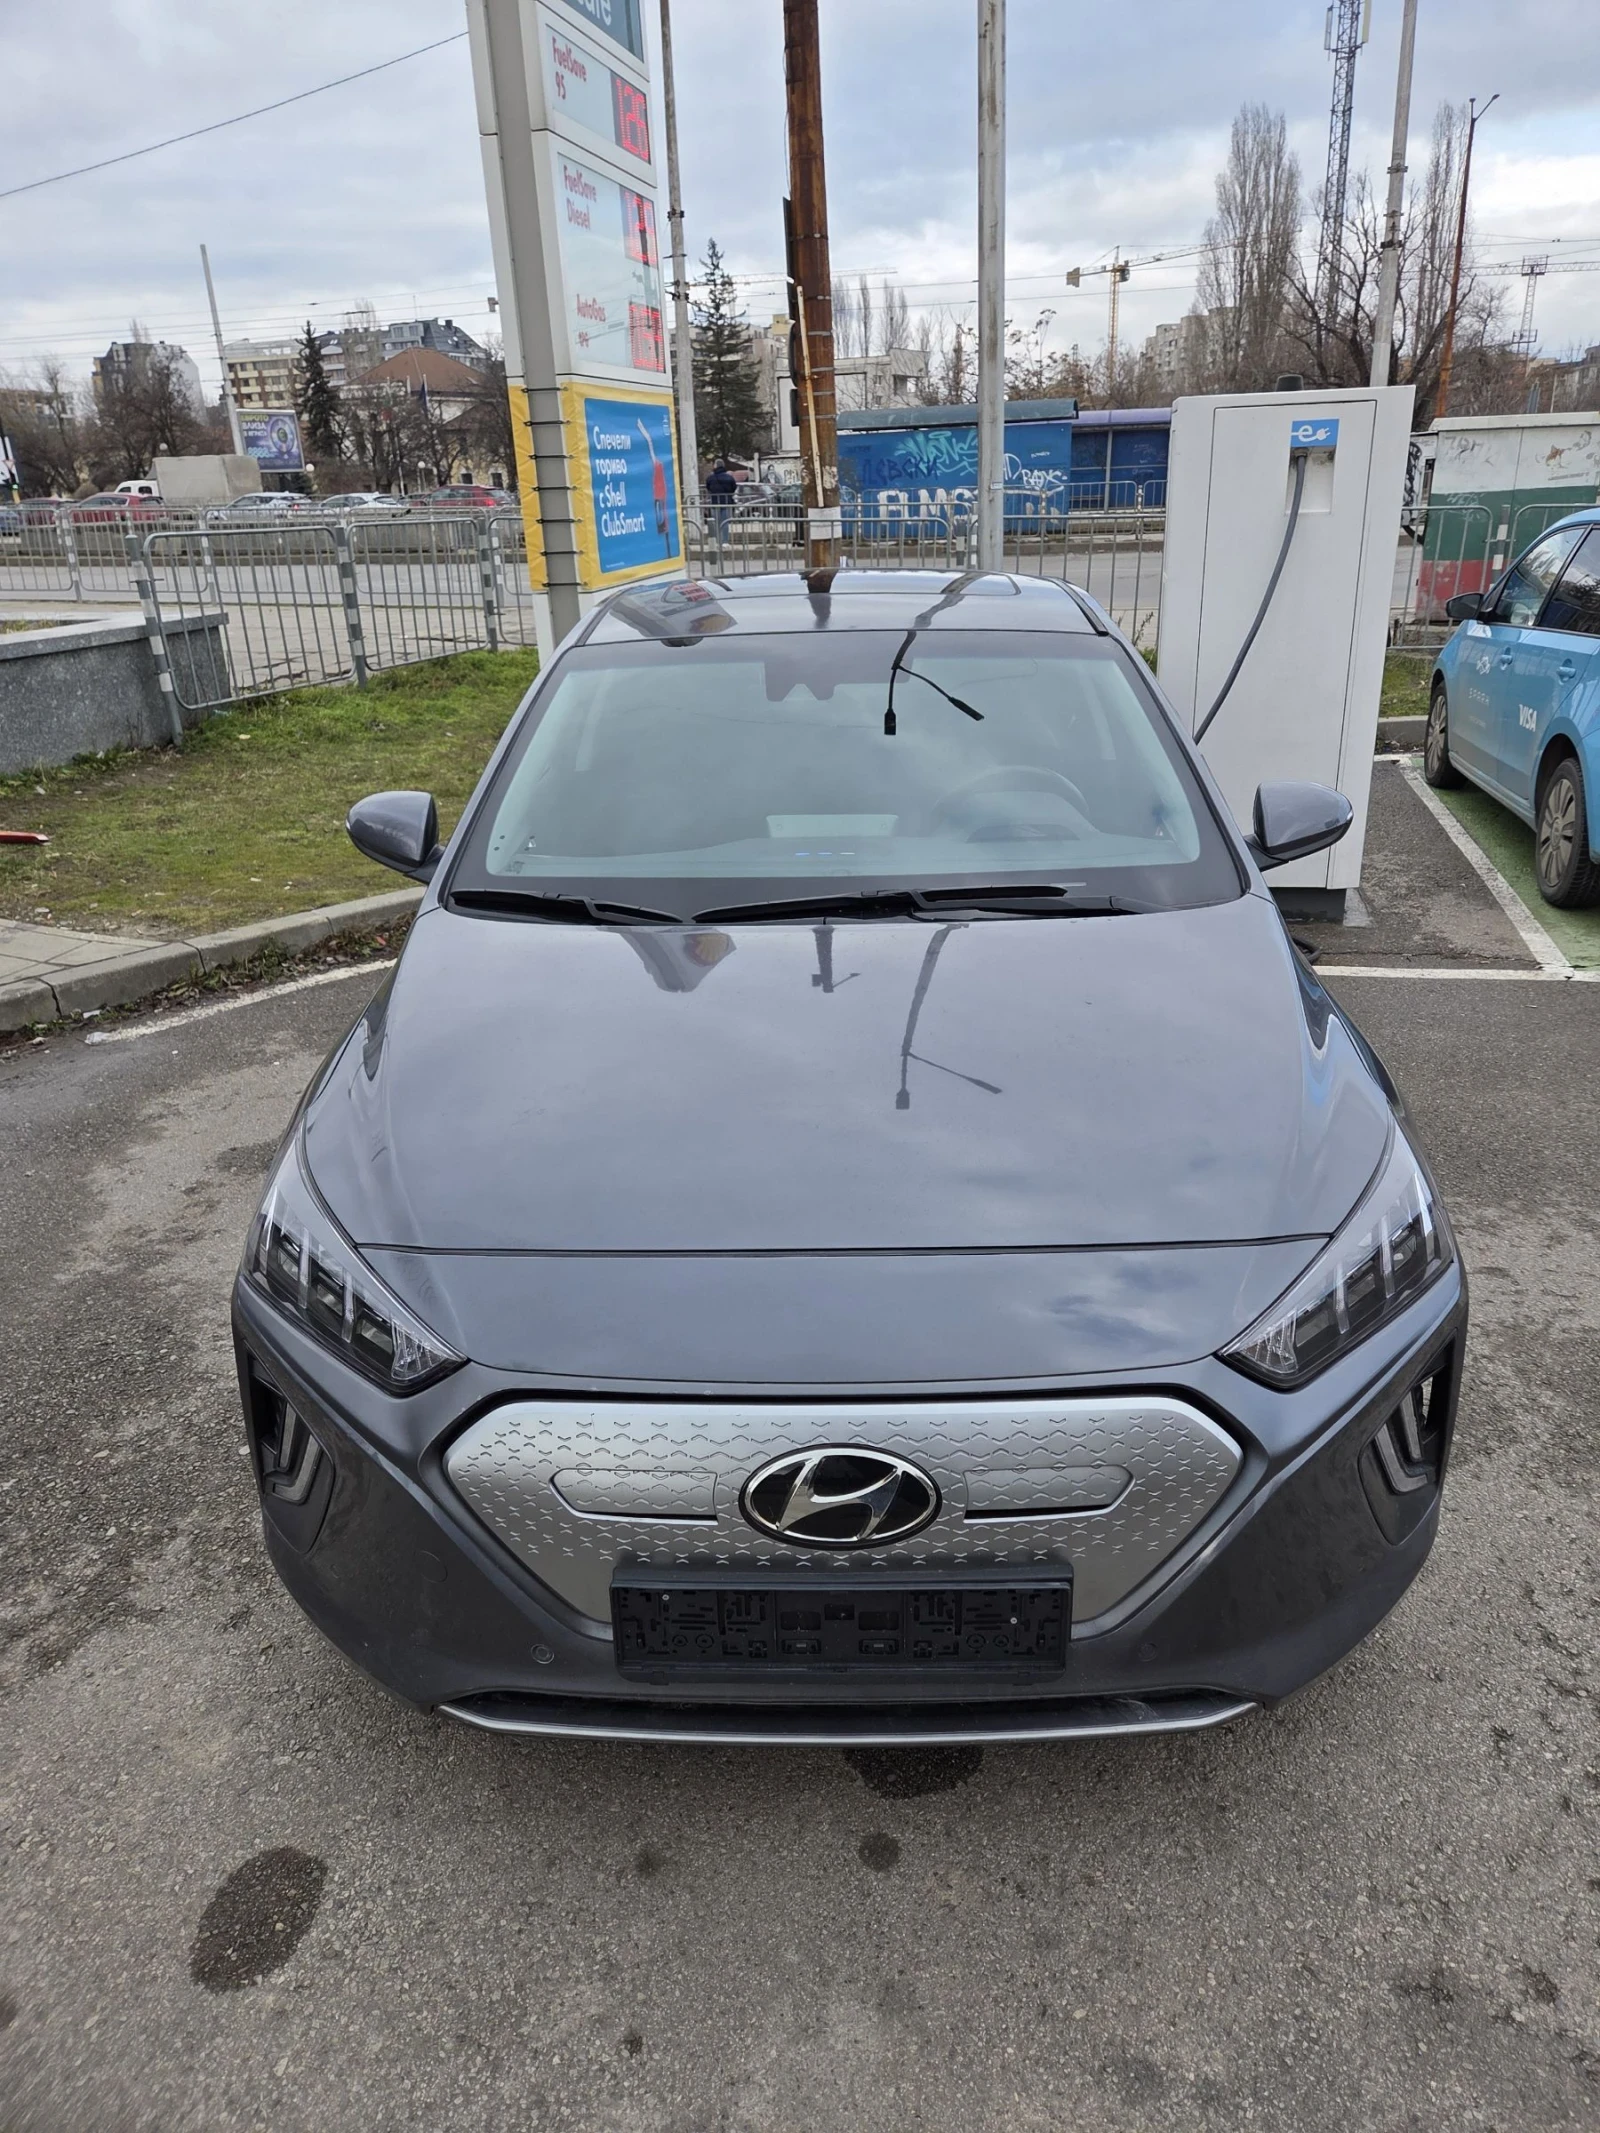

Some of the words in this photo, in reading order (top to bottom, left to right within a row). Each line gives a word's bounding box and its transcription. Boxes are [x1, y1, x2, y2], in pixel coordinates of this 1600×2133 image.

[552, 35, 587, 82] FuelSave
[555, 71, 566, 100] 95
[563, 163, 597, 203] FuelSave
[566, 197, 591, 230] Diesel
[593, 426, 631, 450] Спечели
[596, 458, 627, 481] гориво
[605, 482, 626, 507] Shell
[601, 513, 646, 538] ClubSmart
[1519, 703, 1538, 732] VISA
